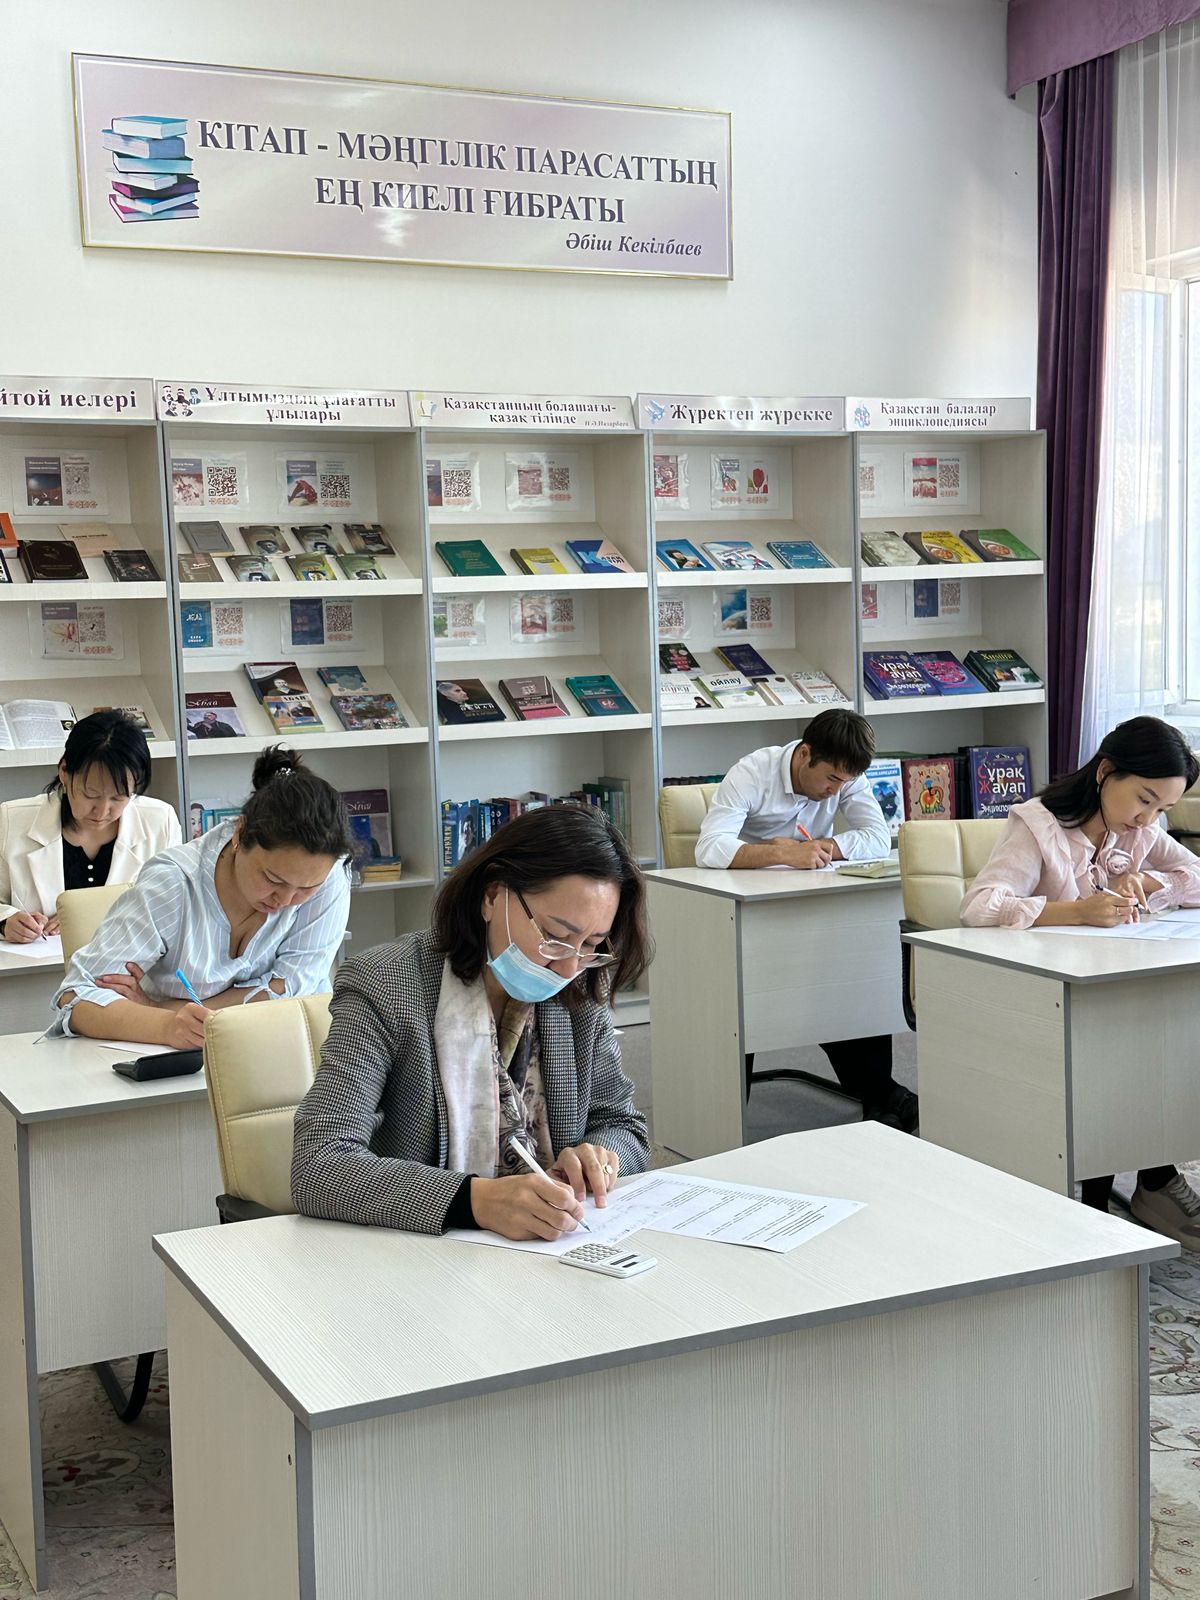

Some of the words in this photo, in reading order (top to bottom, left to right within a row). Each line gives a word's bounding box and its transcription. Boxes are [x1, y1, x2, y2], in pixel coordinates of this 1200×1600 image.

[198, 120, 309, 155] КІТАП
[337, 132, 507, 170] МӘҢГІЛІК
[515, 146, 718, 191] ПАРАСАТТЫҢ
[315, 178, 364, 212] ЕҢ
[371, 181, 475, 213] КИЕЛІ
[484, 189, 625, 223] ҒИБРАТЫ
[566, 233, 612, 251] Әбіш
[618, 236, 702, 256] Кекілбаев
[60, 390, 136, 412] иелері
[205, 387, 317, 405] Ұлтымыздың
[322, 394, 396, 409] ұлағатты
[443, 397, 543, 412] Қазақстанның
[266, 409, 341, 423] ұлылары
[670, 404, 754, 424] Жүректен
[760, 409, 833, 424] жүрекке
[880, 402, 940, 415] Қазақстан
[946, 402, 996, 416] балалар
[530, 412, 576, 425] тілінде
[888, 417, 987, 427] энциклопедиясы
[977, 766, 1025, 783] Сұрақ
[978, 780, 1026, 797] Жауап
